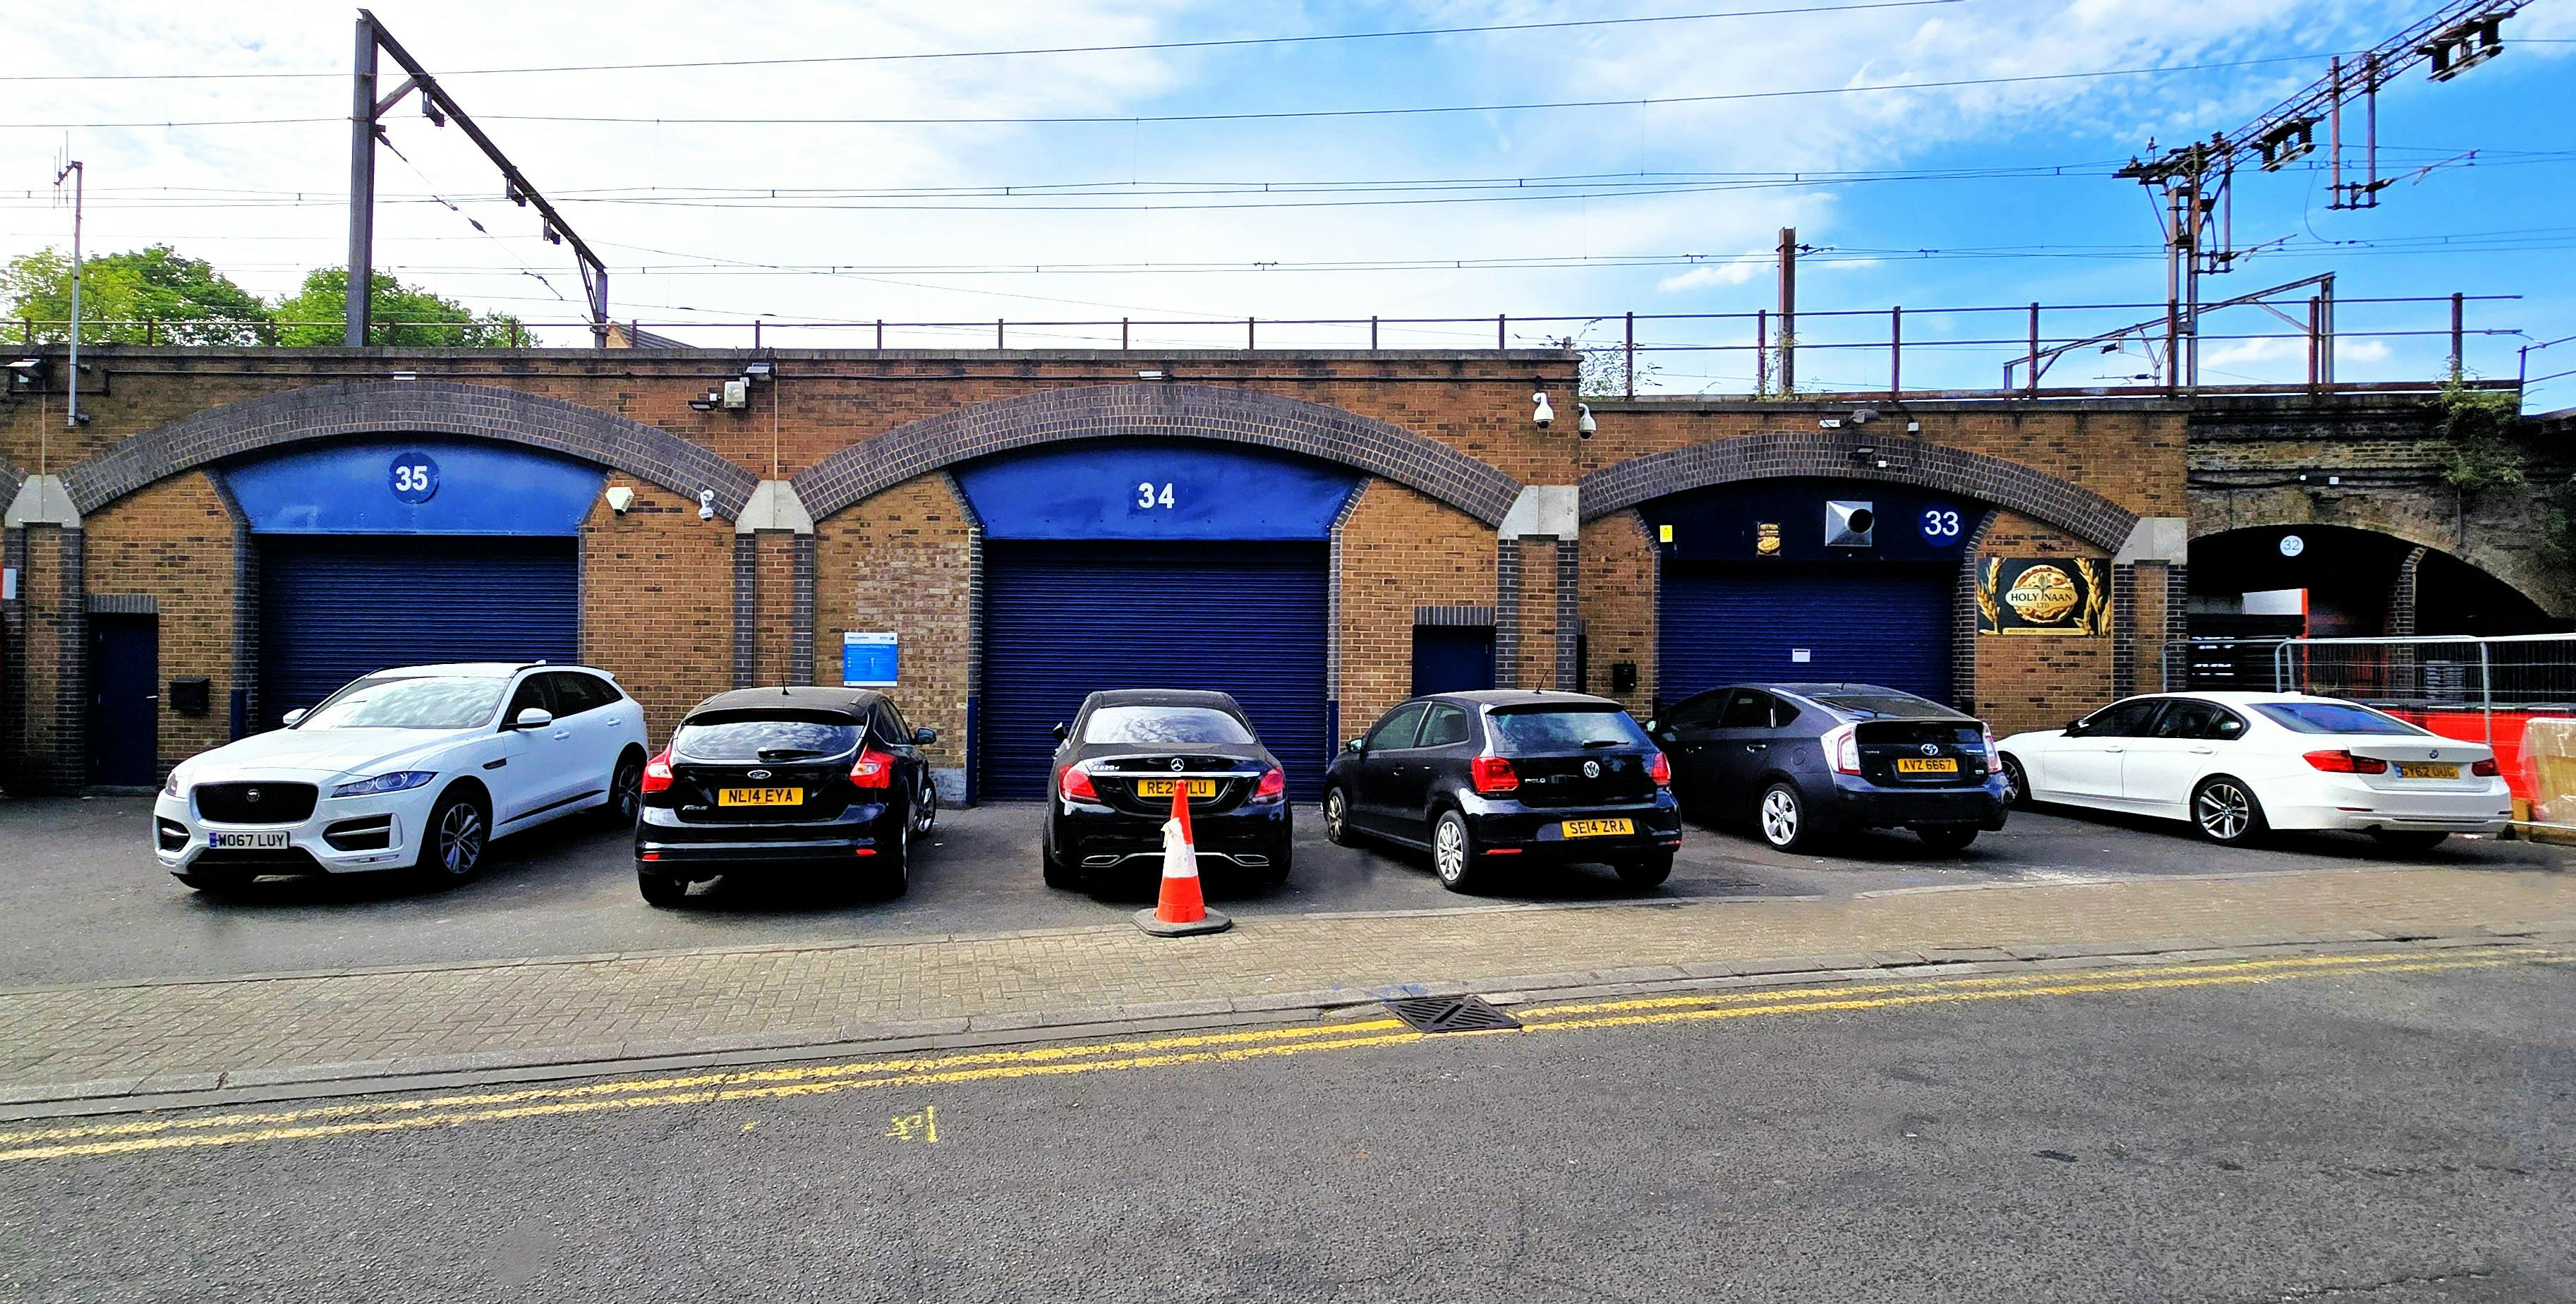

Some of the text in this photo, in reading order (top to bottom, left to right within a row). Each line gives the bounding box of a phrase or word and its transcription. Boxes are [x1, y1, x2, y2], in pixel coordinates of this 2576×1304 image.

[395, 466, 428, 492] 35
[1138, 482, 1175, 509] 34
[1925, 510, 1959, 536] 33
[2284, 540, 2300, 550] 32
[2011, 593, 2072, 602] HOLY NAAN
[1904, 760, 1952, 771] AVZ 6667
[1147, 781, 1177, 794] RE2
[728, 789, 793, 803] NL14 EYA
[1569, 820, 1626, 834] SE14 ZRA
[258, 834, 284, 847] LUY
